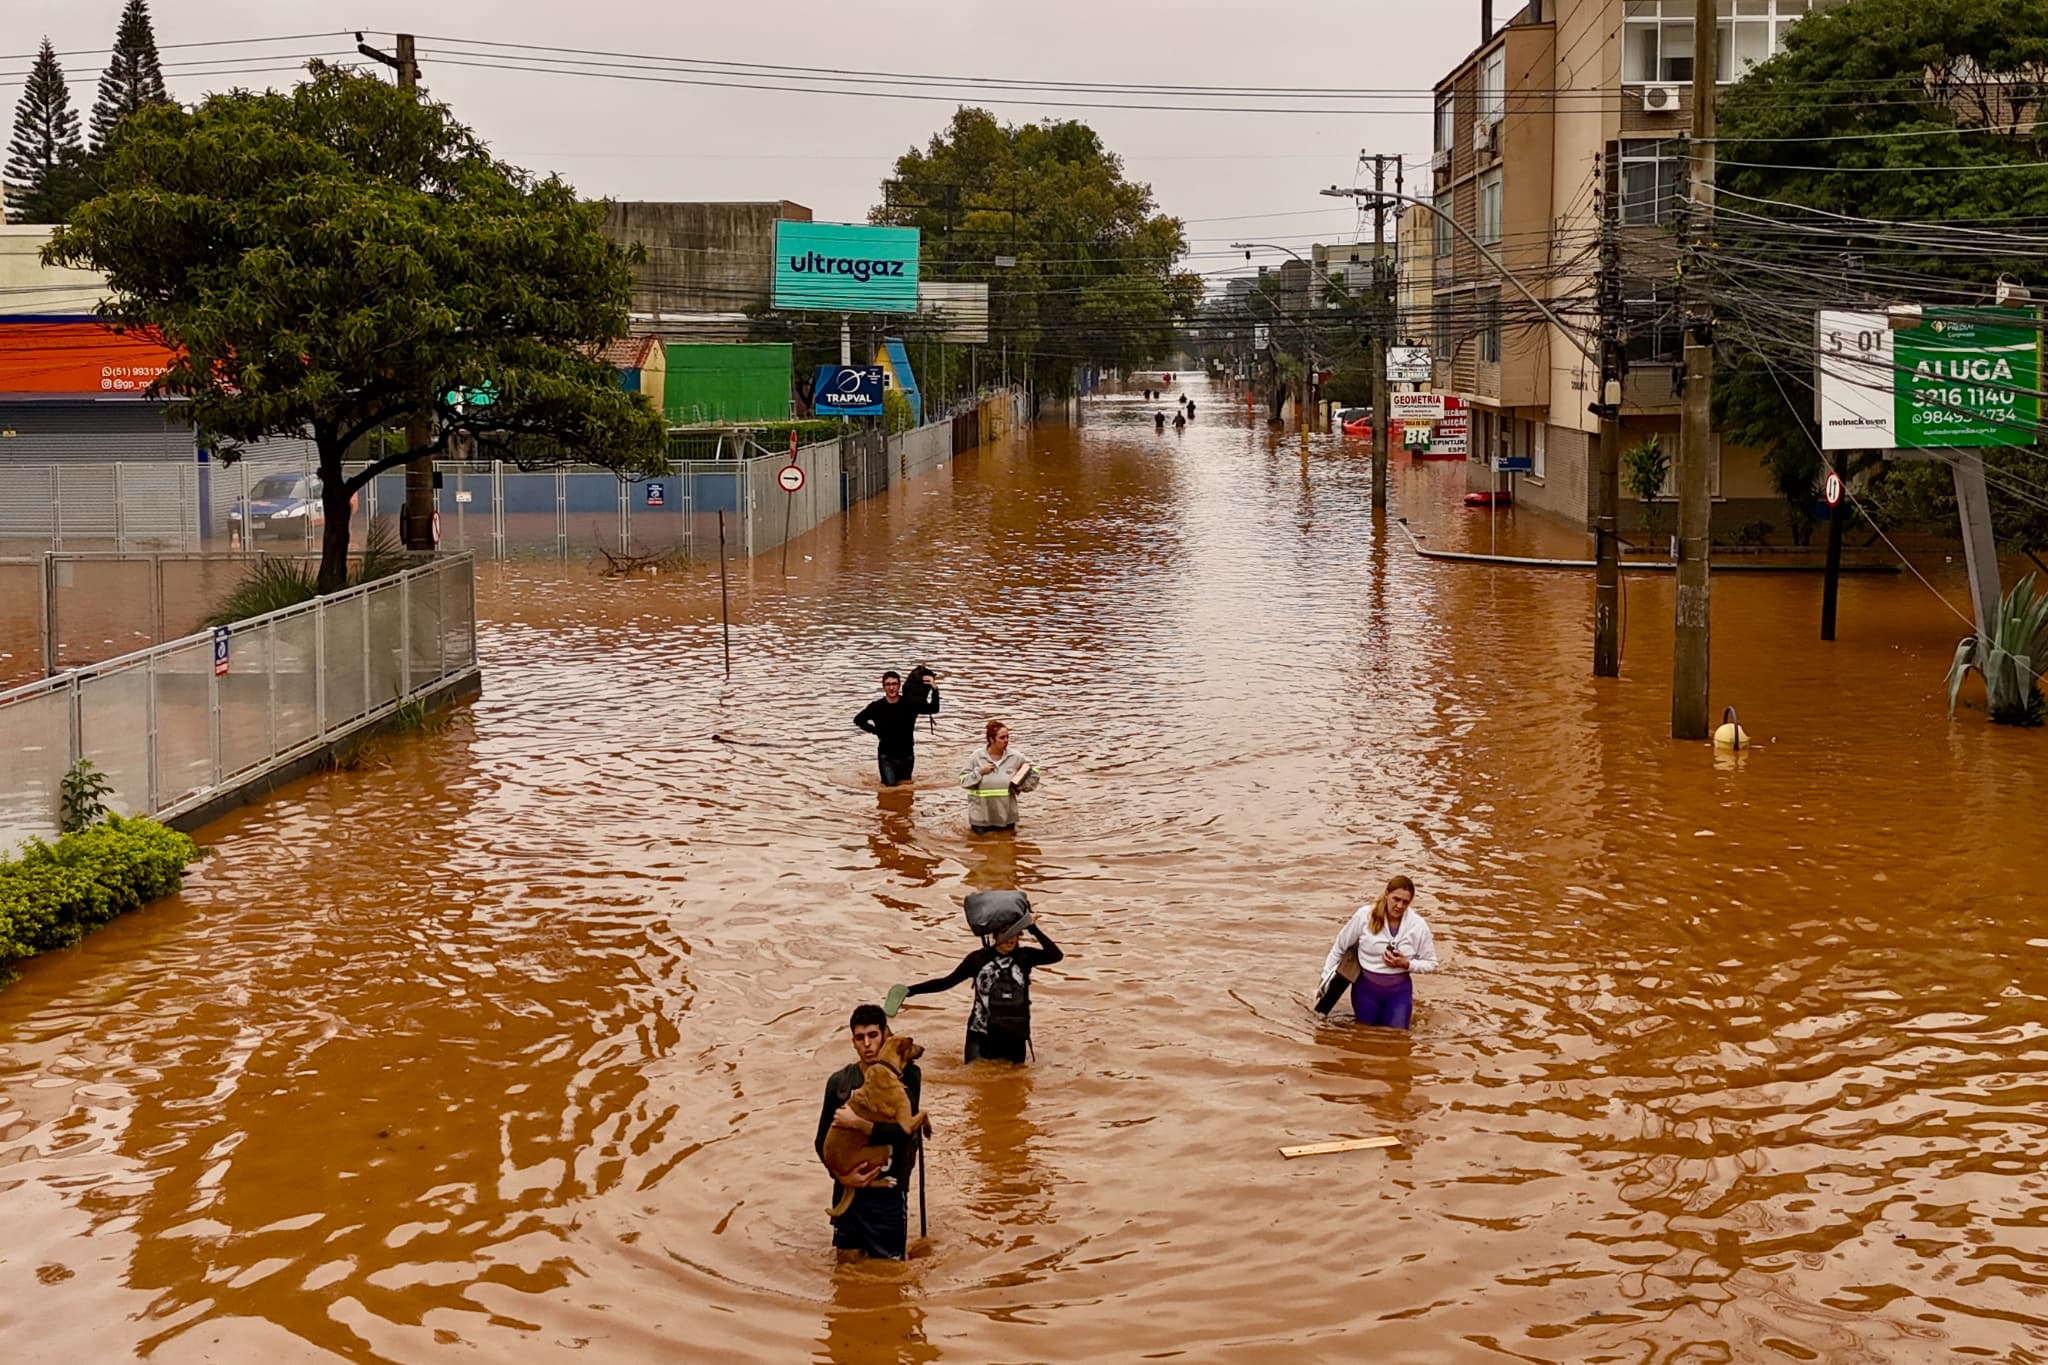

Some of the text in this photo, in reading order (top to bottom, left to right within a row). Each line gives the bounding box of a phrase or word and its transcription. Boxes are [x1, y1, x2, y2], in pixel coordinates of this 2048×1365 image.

[790, 250, 904, 282] ultragaz
[112, 367, 131, 377] (51)
[1912, 358, 2013, 382] ALUGA
[826, 393, 872, 402] TRAPVAL
[1394, 395, 1441, 404] GEOMETRIA
[1966, 387, 2016, 405] 1140
[1405, 430, 1430, 443] BR
